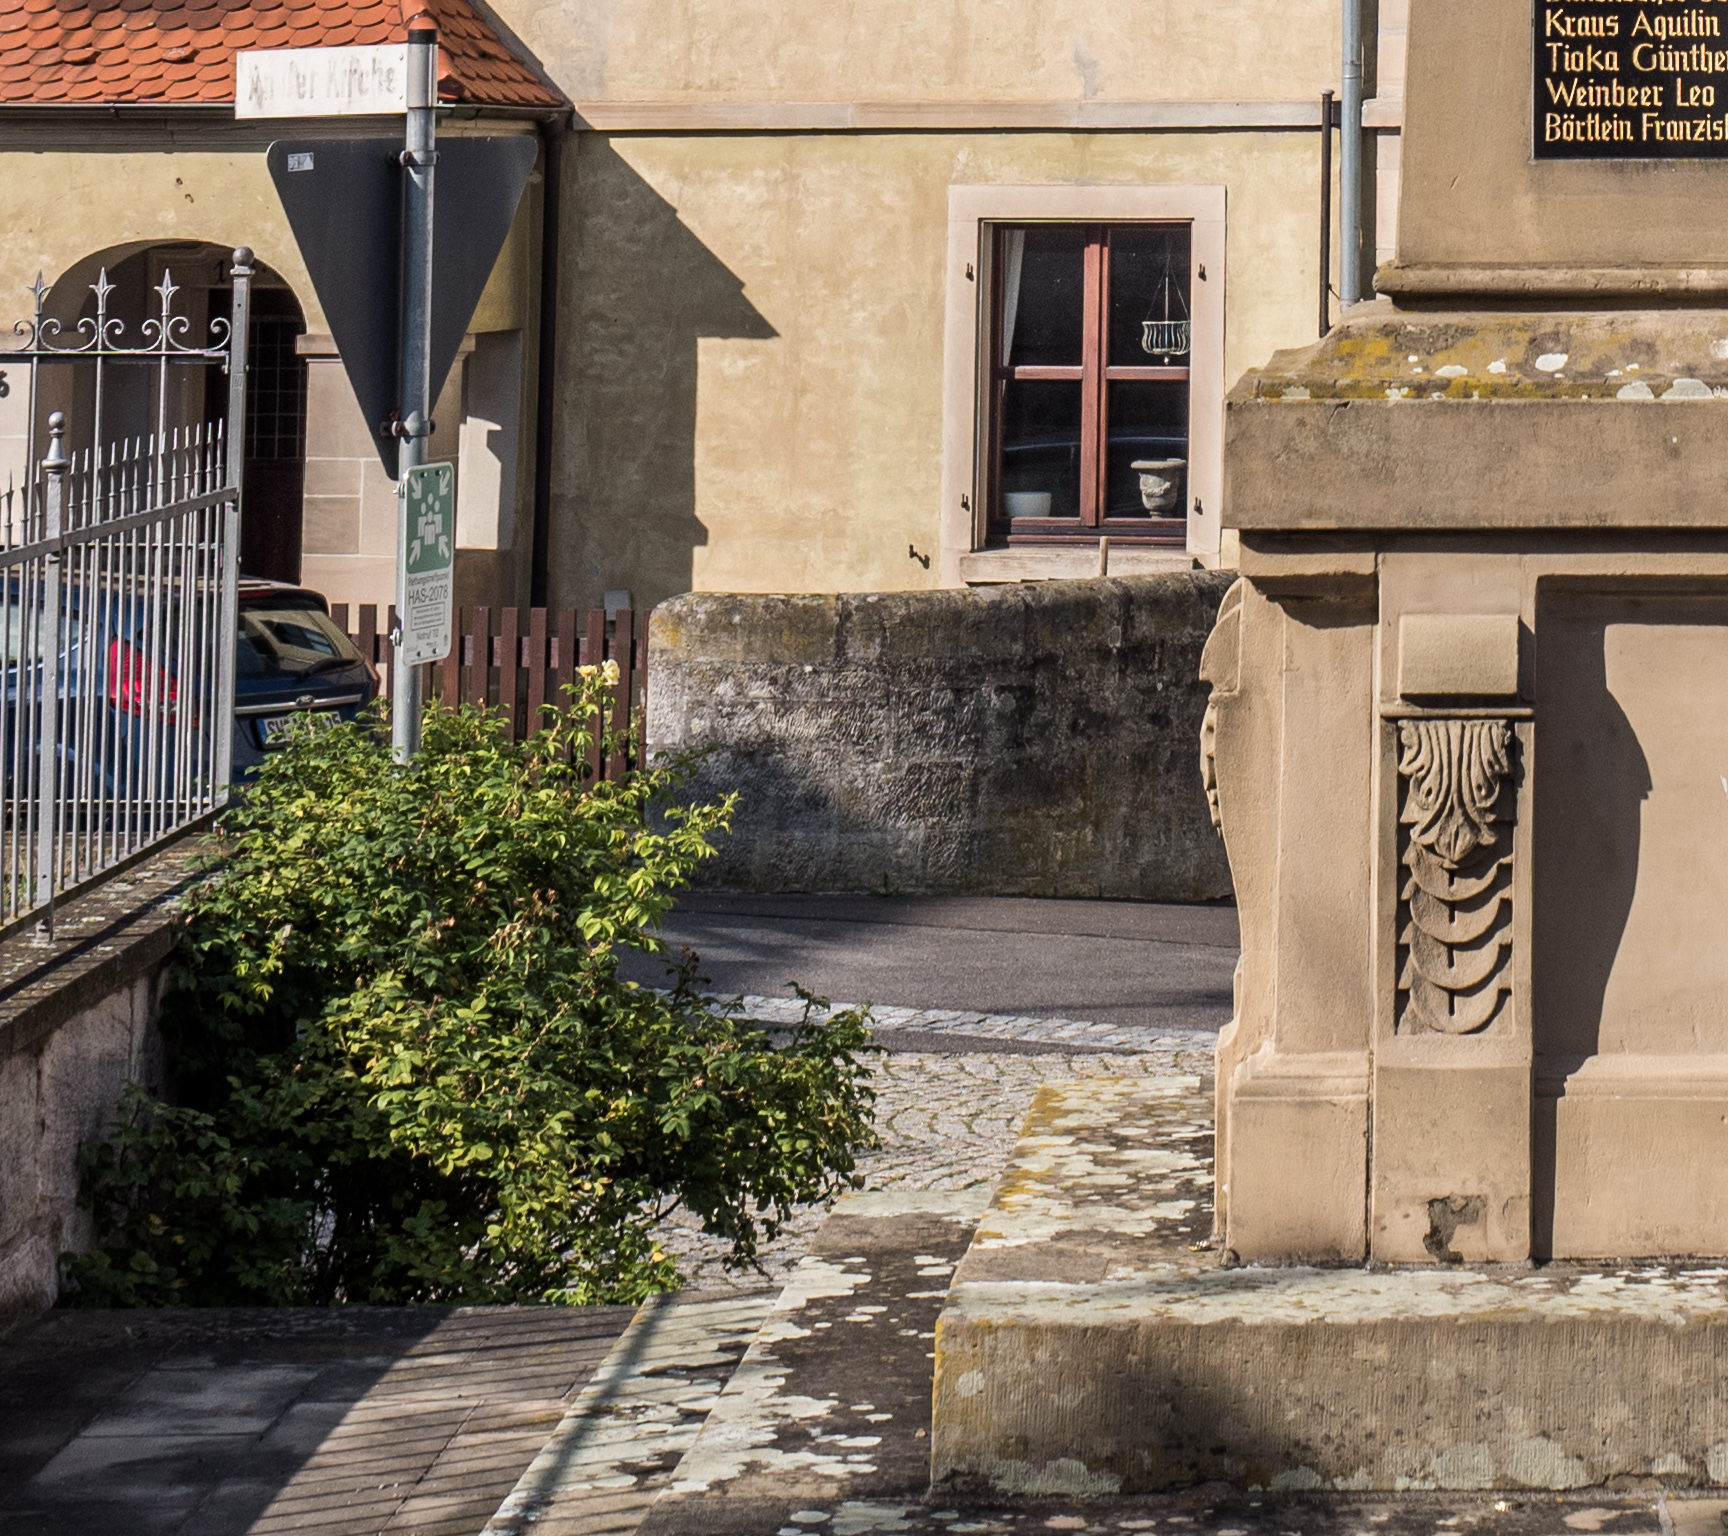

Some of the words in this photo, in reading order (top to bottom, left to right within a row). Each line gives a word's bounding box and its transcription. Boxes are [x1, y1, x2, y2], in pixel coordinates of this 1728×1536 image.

[1545, 8, 1619, 38] Kraus
[1630, 8, 1721, 42] Aquilin
[1545, 77, 1664, 108] Weinbeer
[1676, 77, 1715, 107] Leo
[408, 584, 449, 606] HAS-2078
